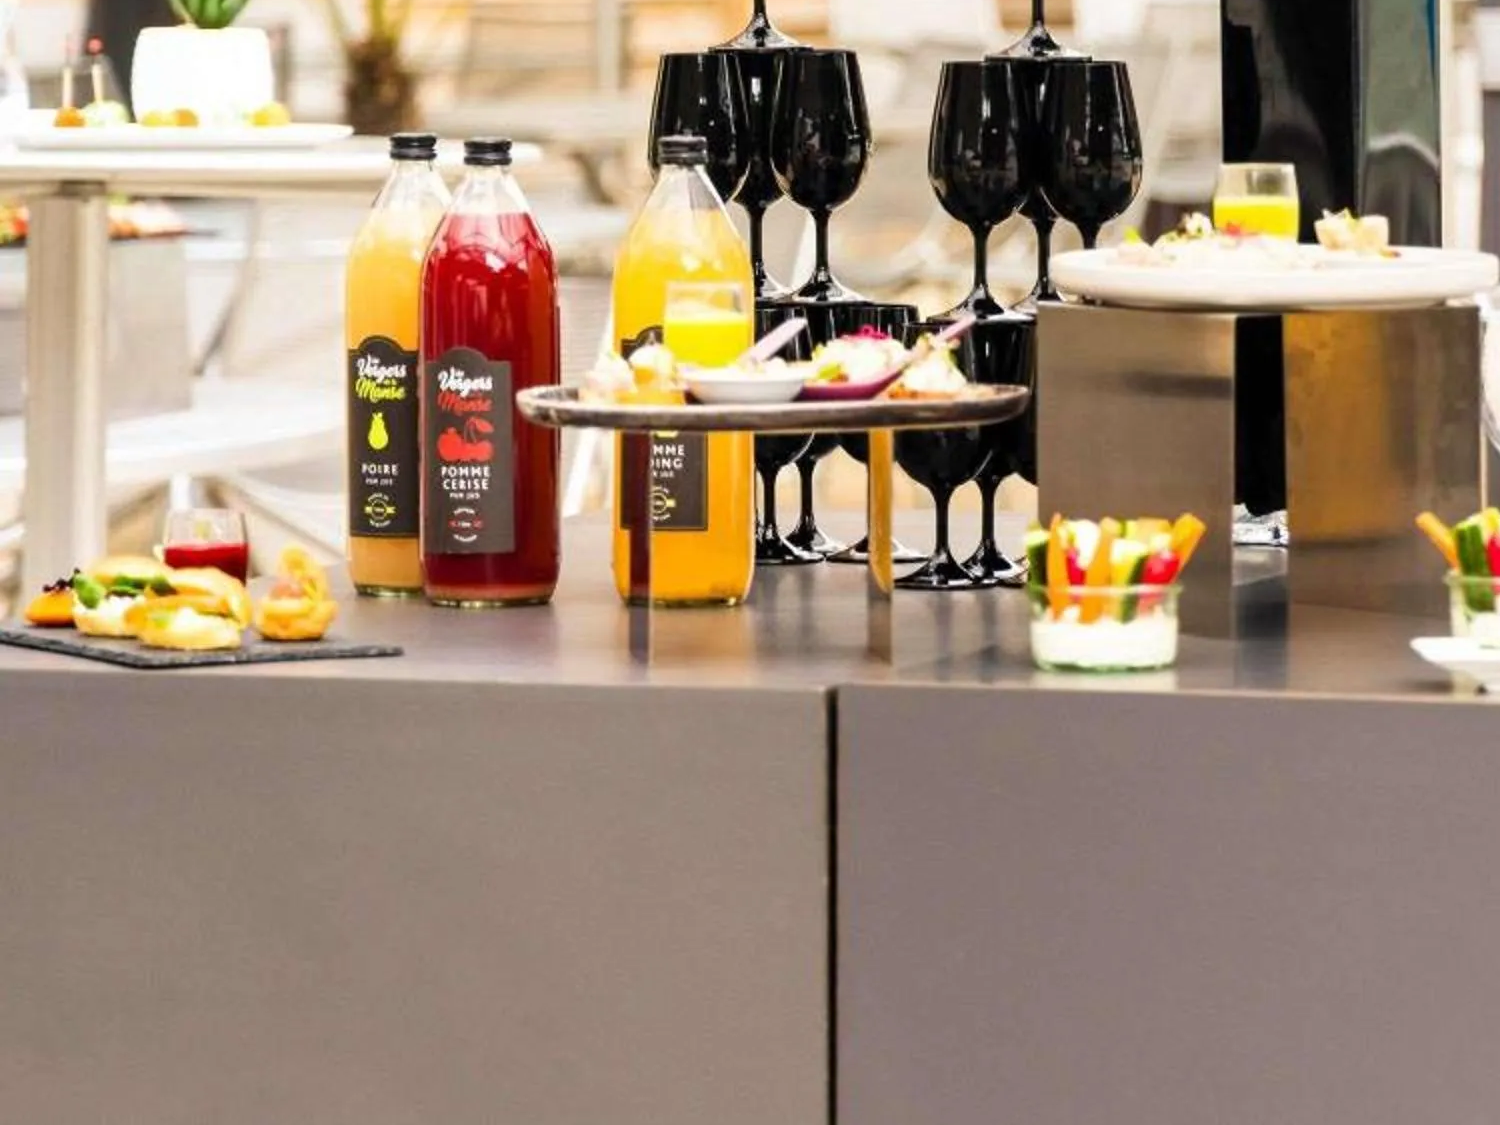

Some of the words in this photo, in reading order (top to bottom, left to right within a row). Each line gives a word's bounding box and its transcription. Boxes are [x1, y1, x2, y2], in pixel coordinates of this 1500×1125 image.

[653, 444, 685, 456] MME
[361, 463, 400, 475] POIRE
[441, 466, 490, 478] POMME
[443, 478, 489, 490] CERISE
